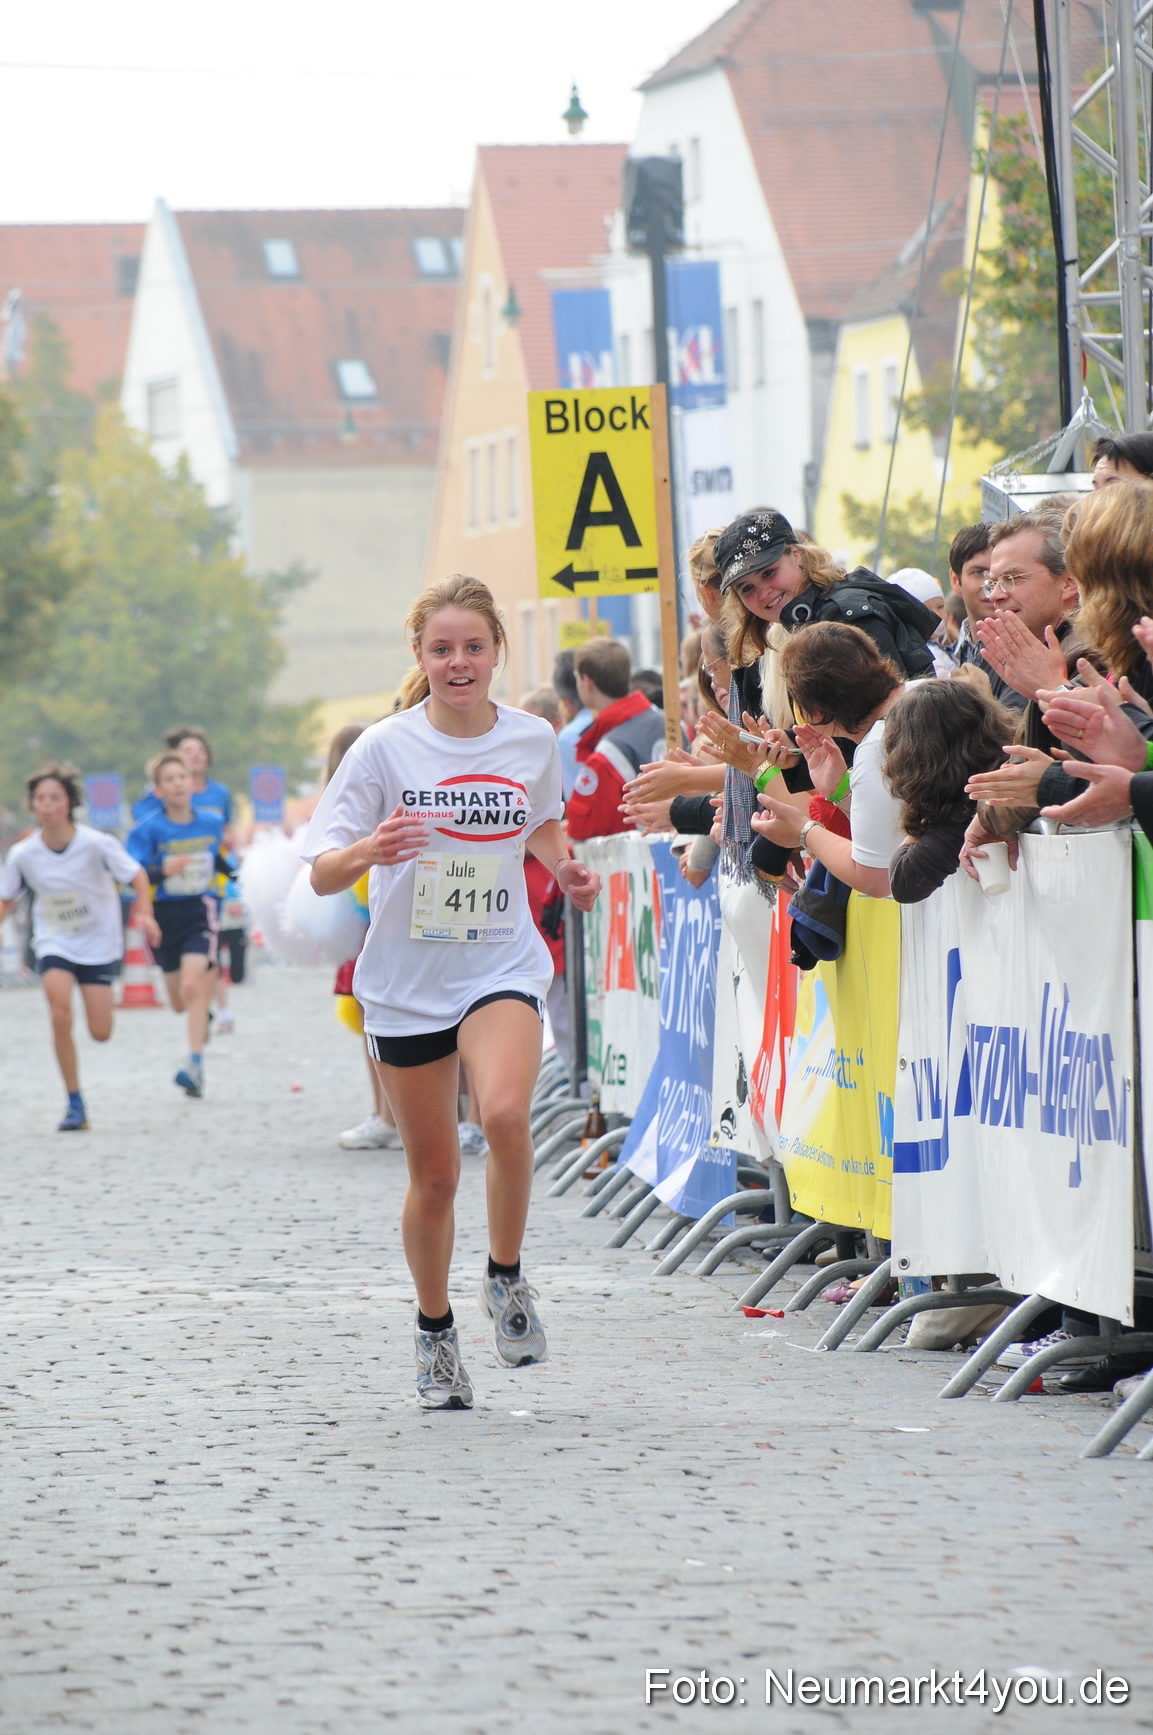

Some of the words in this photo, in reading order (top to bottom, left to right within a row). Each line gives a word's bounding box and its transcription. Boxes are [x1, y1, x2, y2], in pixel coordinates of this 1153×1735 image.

[544, 396, 650, 434] Block
[565, 451, 643, 551] A
[402, 790, 514, 807] GERHART
[516, 797, 525, 806] &
[404, 811, 454, 819] Autohaus
[454, 809, 527, 826] JÄNIG
[446, 861, 475, 878] Jule
[418, 884, 426, 897] J
[445, 888, 509, 913] 4110
[478, 928, 515, 937] PFLEIDERER
